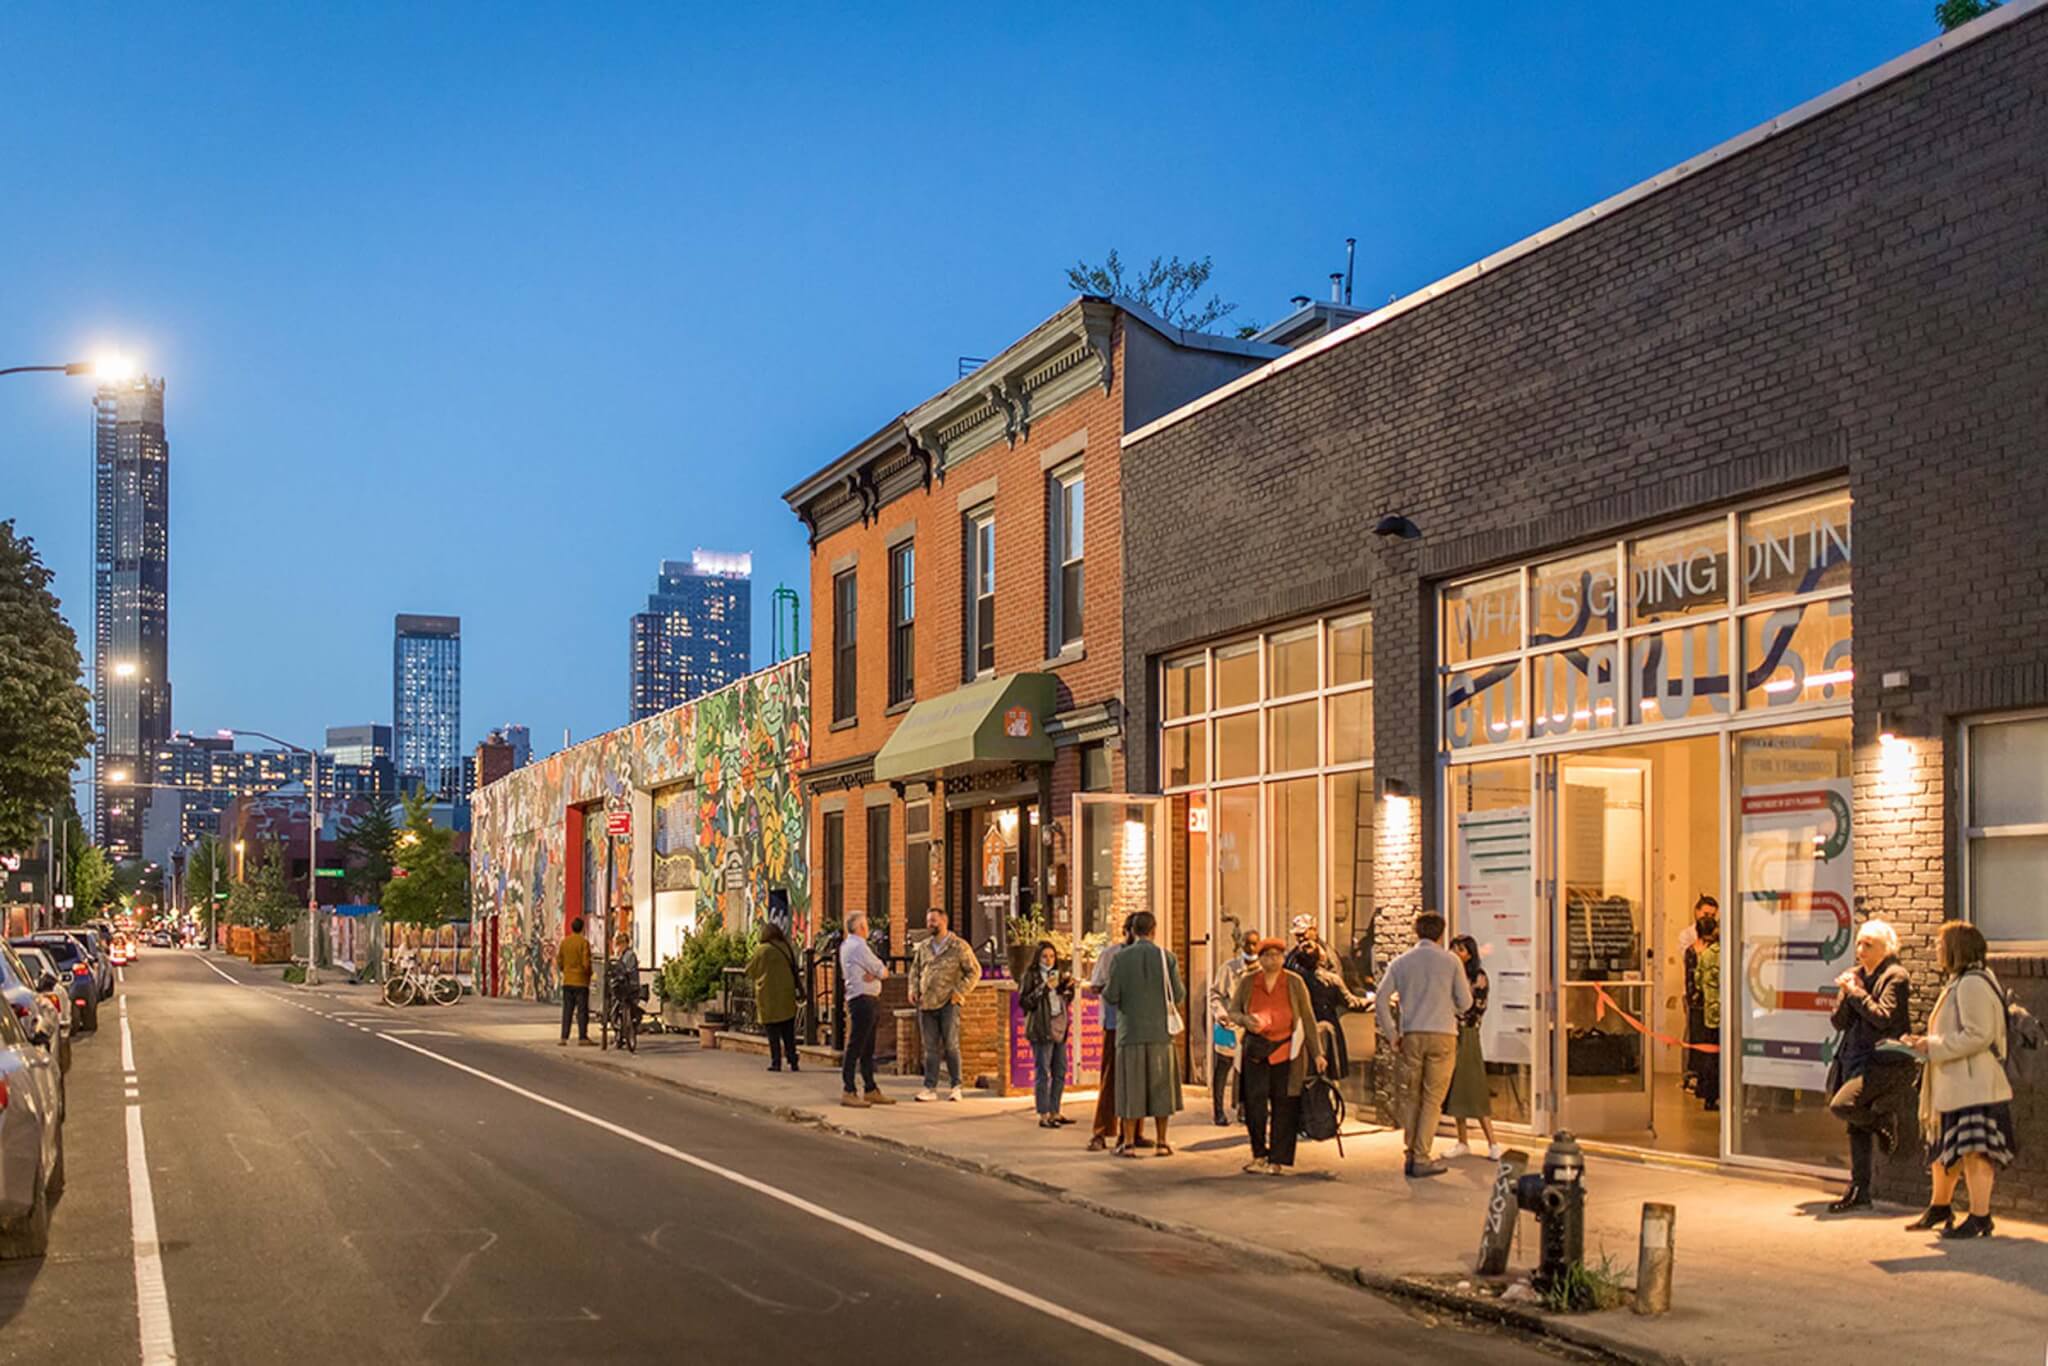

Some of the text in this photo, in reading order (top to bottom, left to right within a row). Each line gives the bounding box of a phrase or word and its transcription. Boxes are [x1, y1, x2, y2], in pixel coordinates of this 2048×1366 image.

[1454, 579, 1578, 647] WHAT'S
[1587, 545, 1717, 616] GOING
[1809, 515, 1851, 570] IN
